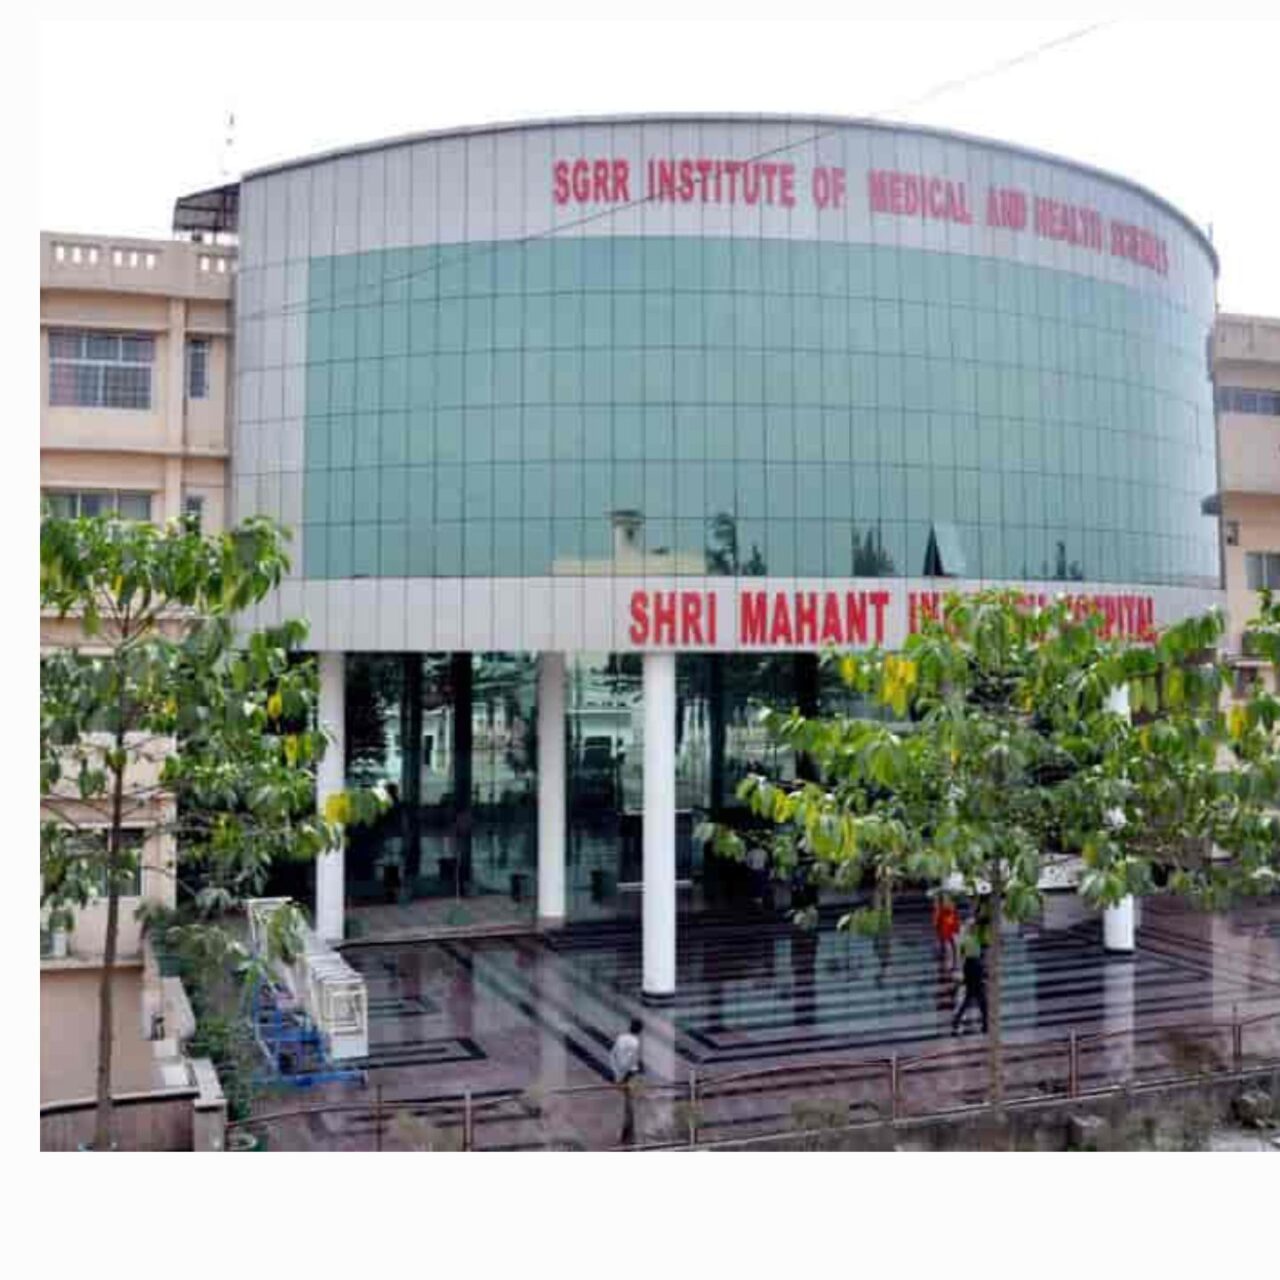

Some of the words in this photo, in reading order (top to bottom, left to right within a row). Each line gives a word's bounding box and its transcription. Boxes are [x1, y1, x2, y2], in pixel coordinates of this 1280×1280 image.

[552, 158, 630, 206] SGRR
[648, 160, 797, 208] INSTITUTE
[812, 166, 846, 210] OF
[868, 168, 973, 226] MEDICAL
[629, 591, 718, 645] SHRI
[740, 590, 889, 644] MAHANT
